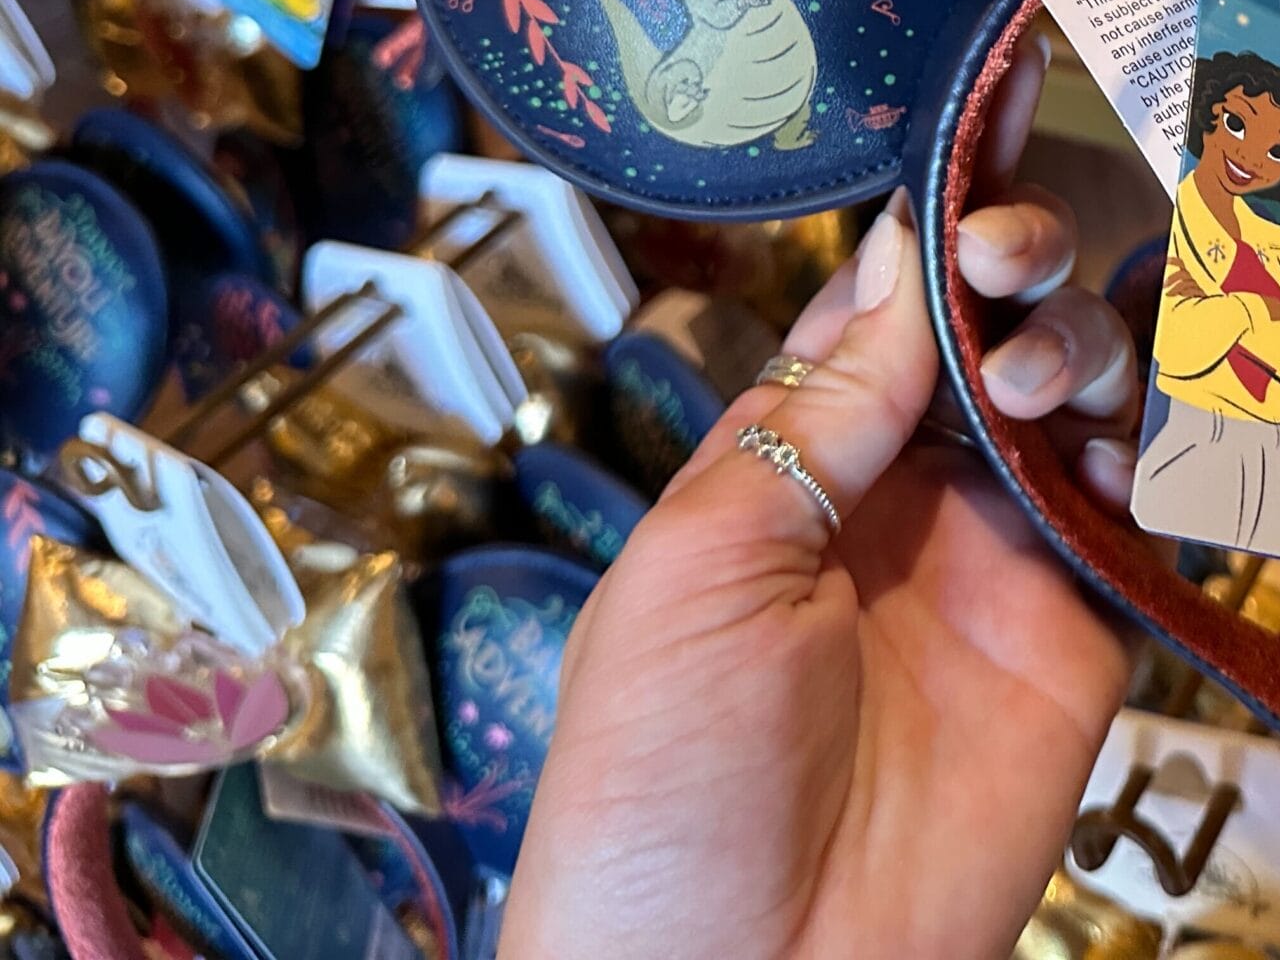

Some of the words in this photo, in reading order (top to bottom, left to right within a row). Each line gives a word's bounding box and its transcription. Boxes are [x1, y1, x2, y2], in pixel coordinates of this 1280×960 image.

[1088, 16, 1104, 29] is
[1100, 24, 1125, 45] not
[1124, 11, 1165, 34] cause
[1111, 40, 1137, 60] any
[1121, 51, 1162, 76] cause
[1140, 92, 1160, 109] by
[1160, 82, 1184, 100] the
